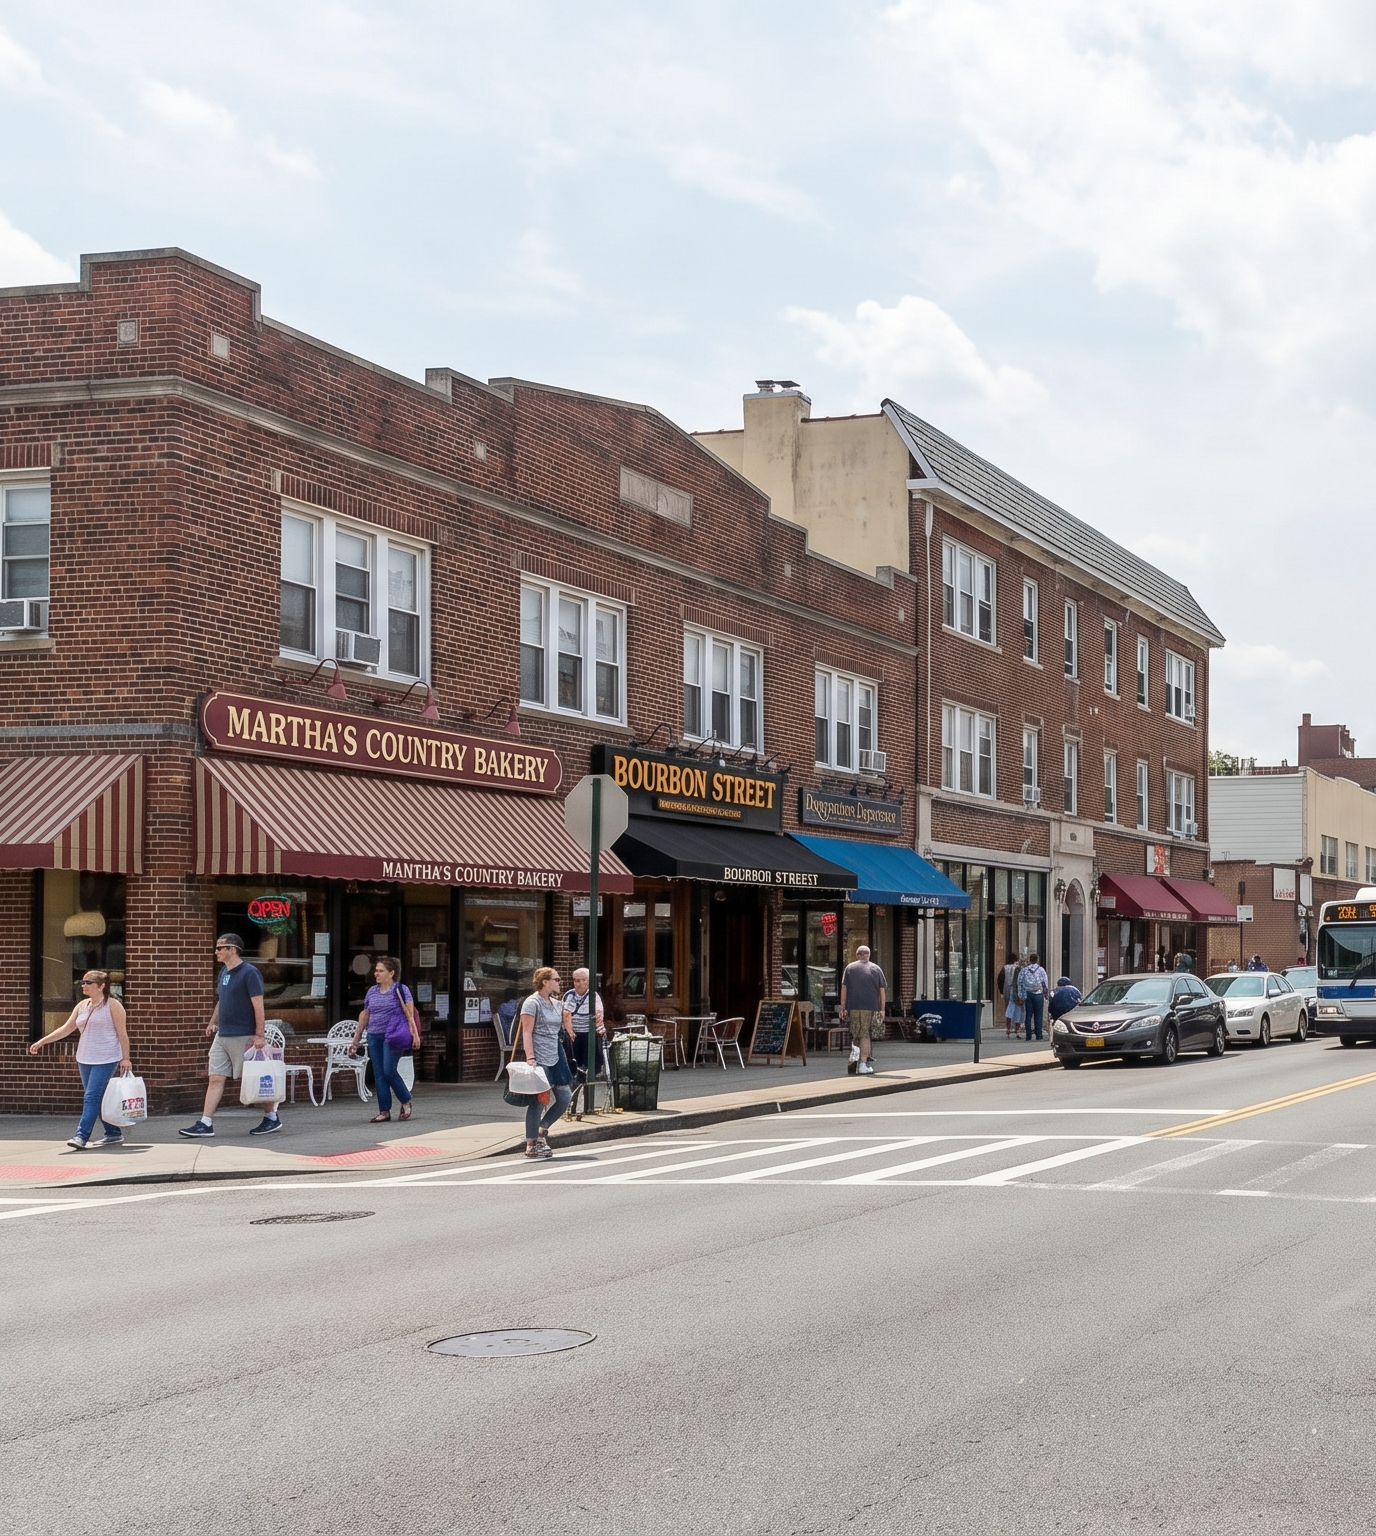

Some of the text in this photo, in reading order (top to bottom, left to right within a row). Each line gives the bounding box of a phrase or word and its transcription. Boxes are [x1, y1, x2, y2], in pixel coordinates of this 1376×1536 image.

[227, 705, 549, 784] MARTHA'S COUNTRY BAKERY
[613, 755, 708, 799] BOURBON
[712, 772, 776, 809] STREET
[382, 861, 564, 887] MANTHA'S COUNTRY BAKERY
[247, 900, 291, 918] OPEN
